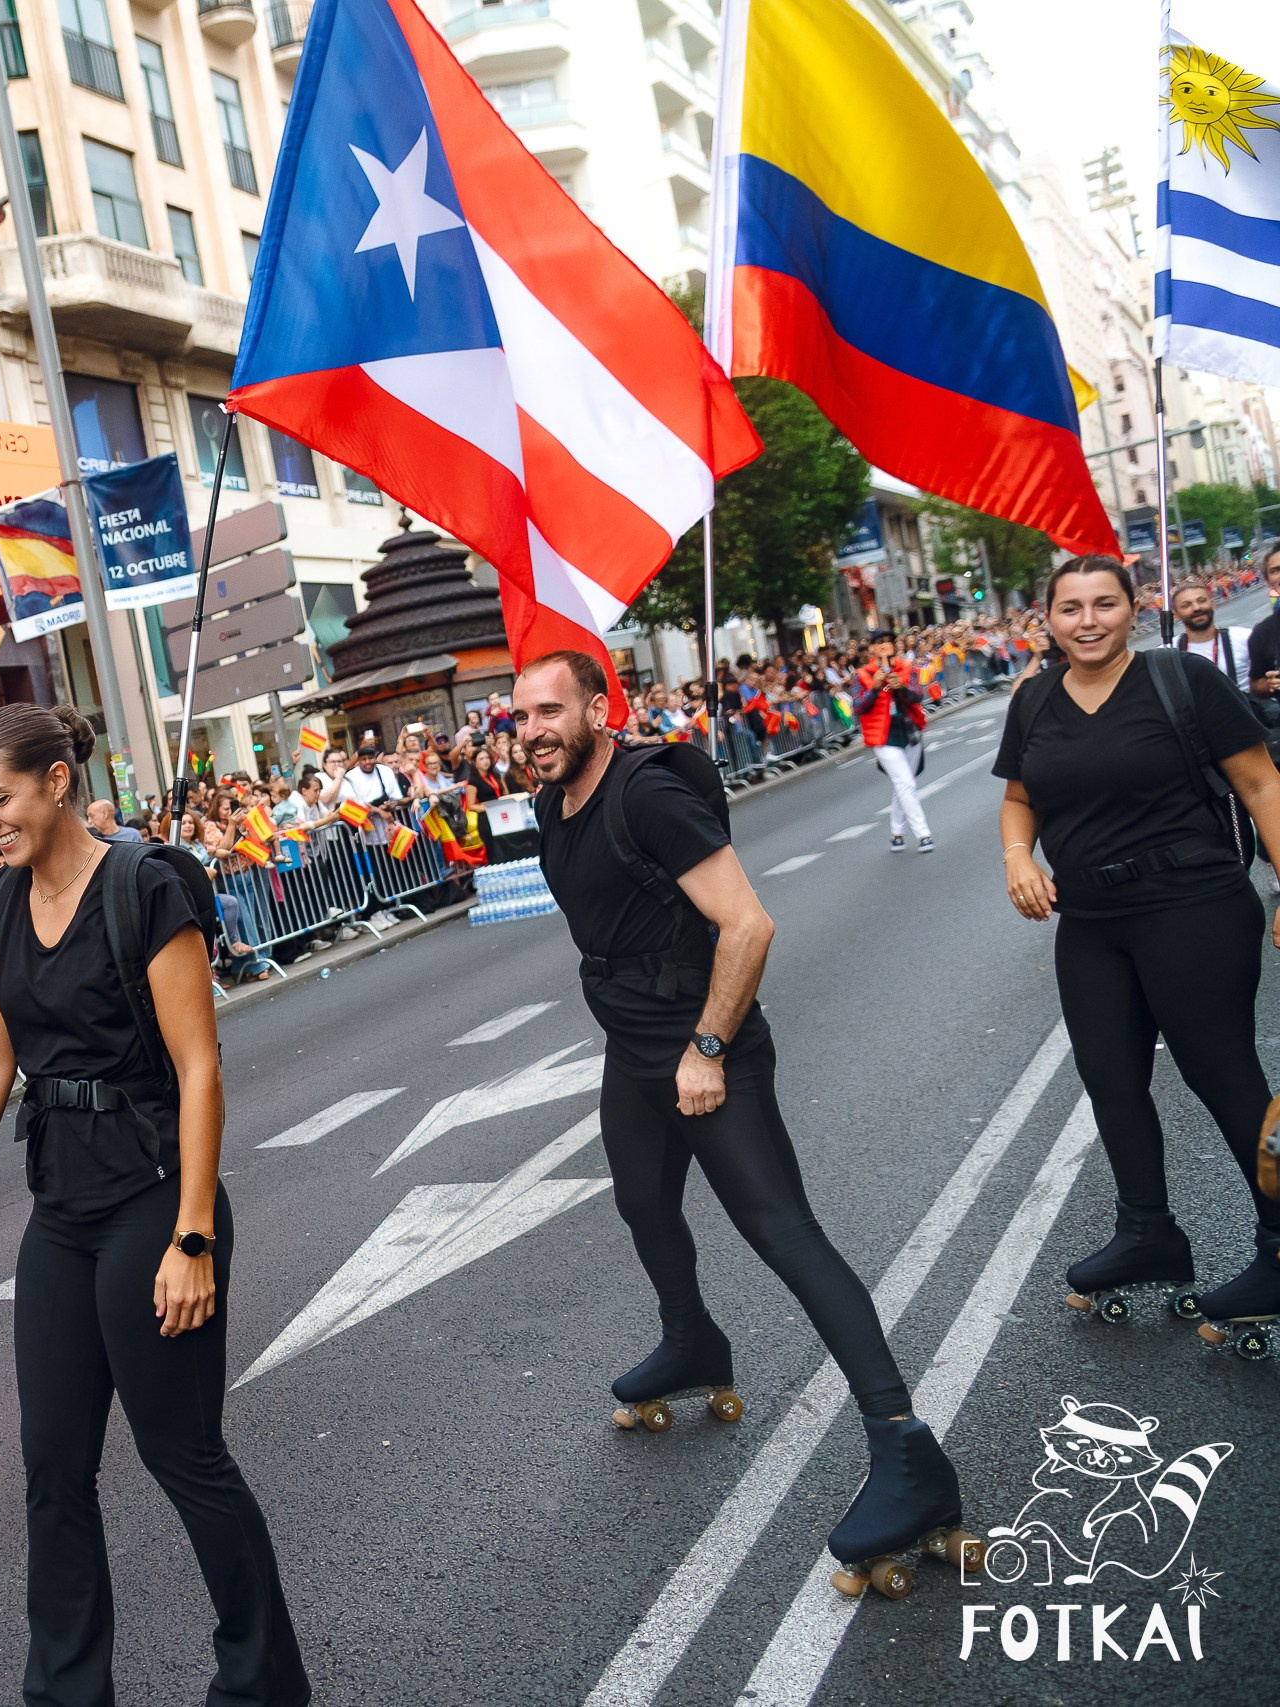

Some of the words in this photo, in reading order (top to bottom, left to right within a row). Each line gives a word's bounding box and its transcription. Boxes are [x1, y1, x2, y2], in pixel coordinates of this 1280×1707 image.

[98, 508, 142, 530] FIESTA
[101, 519, 173, 547] NACIONAL
[108, 565, 125, 579] 12
[126, 551, 188, 577] OCTUBRE
